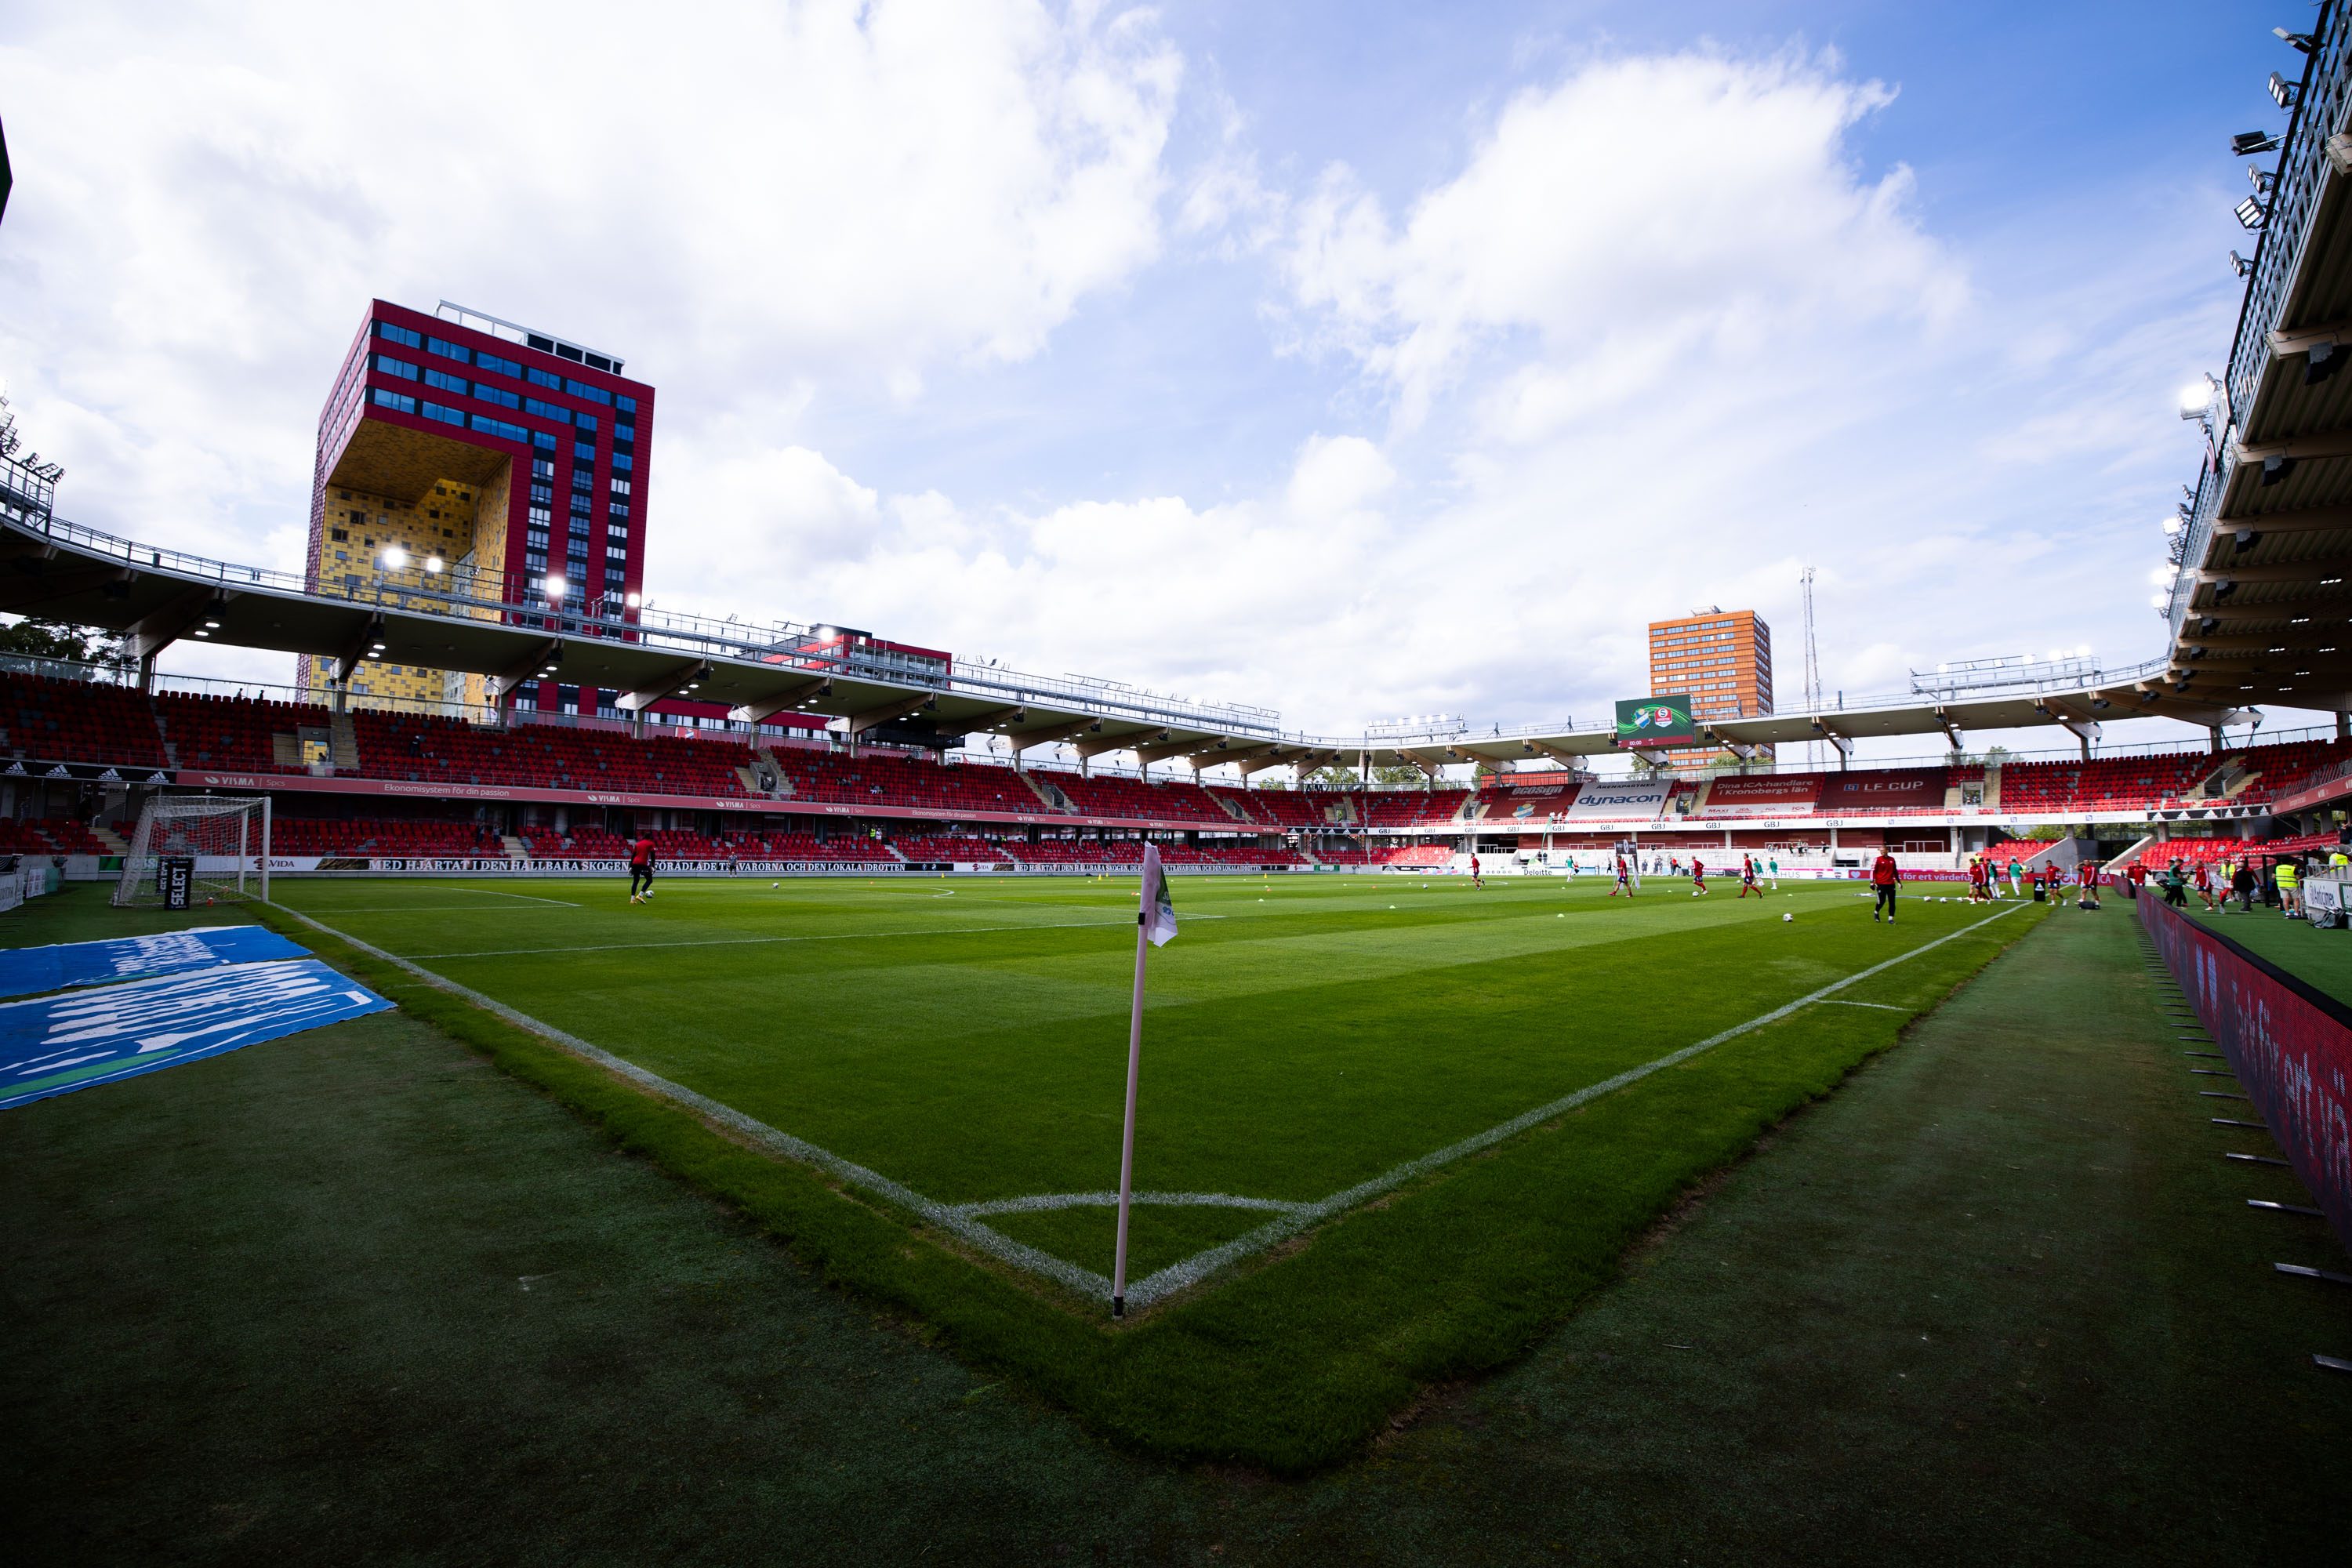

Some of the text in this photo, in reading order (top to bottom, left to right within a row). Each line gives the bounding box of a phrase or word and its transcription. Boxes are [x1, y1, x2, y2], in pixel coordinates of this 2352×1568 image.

[222, 777, 255, 786] VISMA
[1743, 779, 1813, 788] ICA-handlare
[1889, 781, 1924, 790] CUP
[384, 784, 451, 795] Ekonomisystem
[480, 789, 510, 798] passion
[1512, 786, 1565, 797] ecosign
[1725, 787, 1788, 796] Kronobergs
[1578, 794, 1662, 807] dynacon
[368, 860, 402, 870] MED
[405, 858, 470, 870] HJÄRTAT
[479, 861, 509, 870] DEN
[510, 859, 579, 870] HÅLLBARA
[655, 860, 717, 871] FÖRÄDLADE
[719, 862, 785, 871] TVARORNA
[786, 862, 806, 871] OCH
[808, 862, 826, 871] DEN
[828, 862, 862, 871] LOKALA
[864, 862, 906, 871] IDROTTEN
[1934, 873, 1970, 881] värdefu
[171, 867, 187, 906] SELECT
